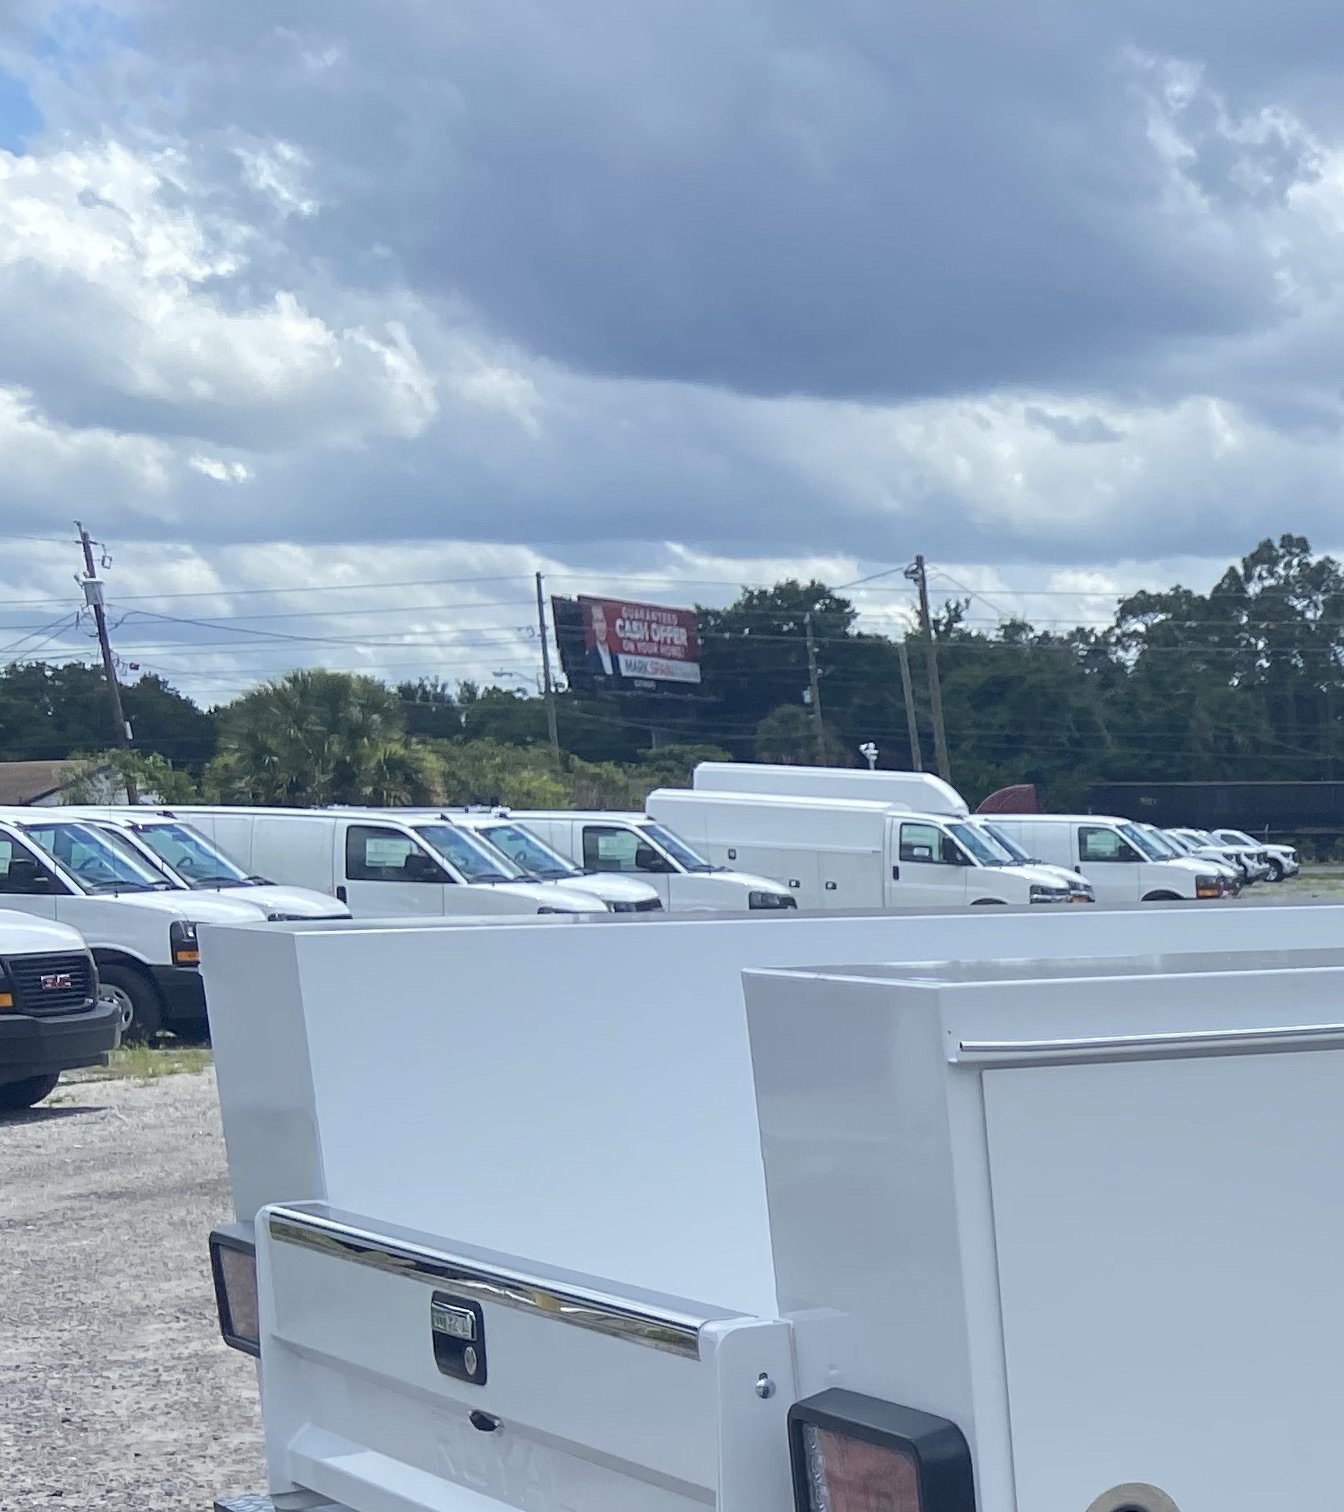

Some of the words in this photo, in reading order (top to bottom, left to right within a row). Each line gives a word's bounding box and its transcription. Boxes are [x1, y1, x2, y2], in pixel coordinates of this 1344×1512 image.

[622, 606, 678, 626] GUARANTEED
[615, 618, 649, 641] CASH
[651, 622, 688, 647] OFFER
[622, 639, 635, 653] ON
[636, 641, 658, 655] YOUR
[41, 973, 72, 989] GMC
